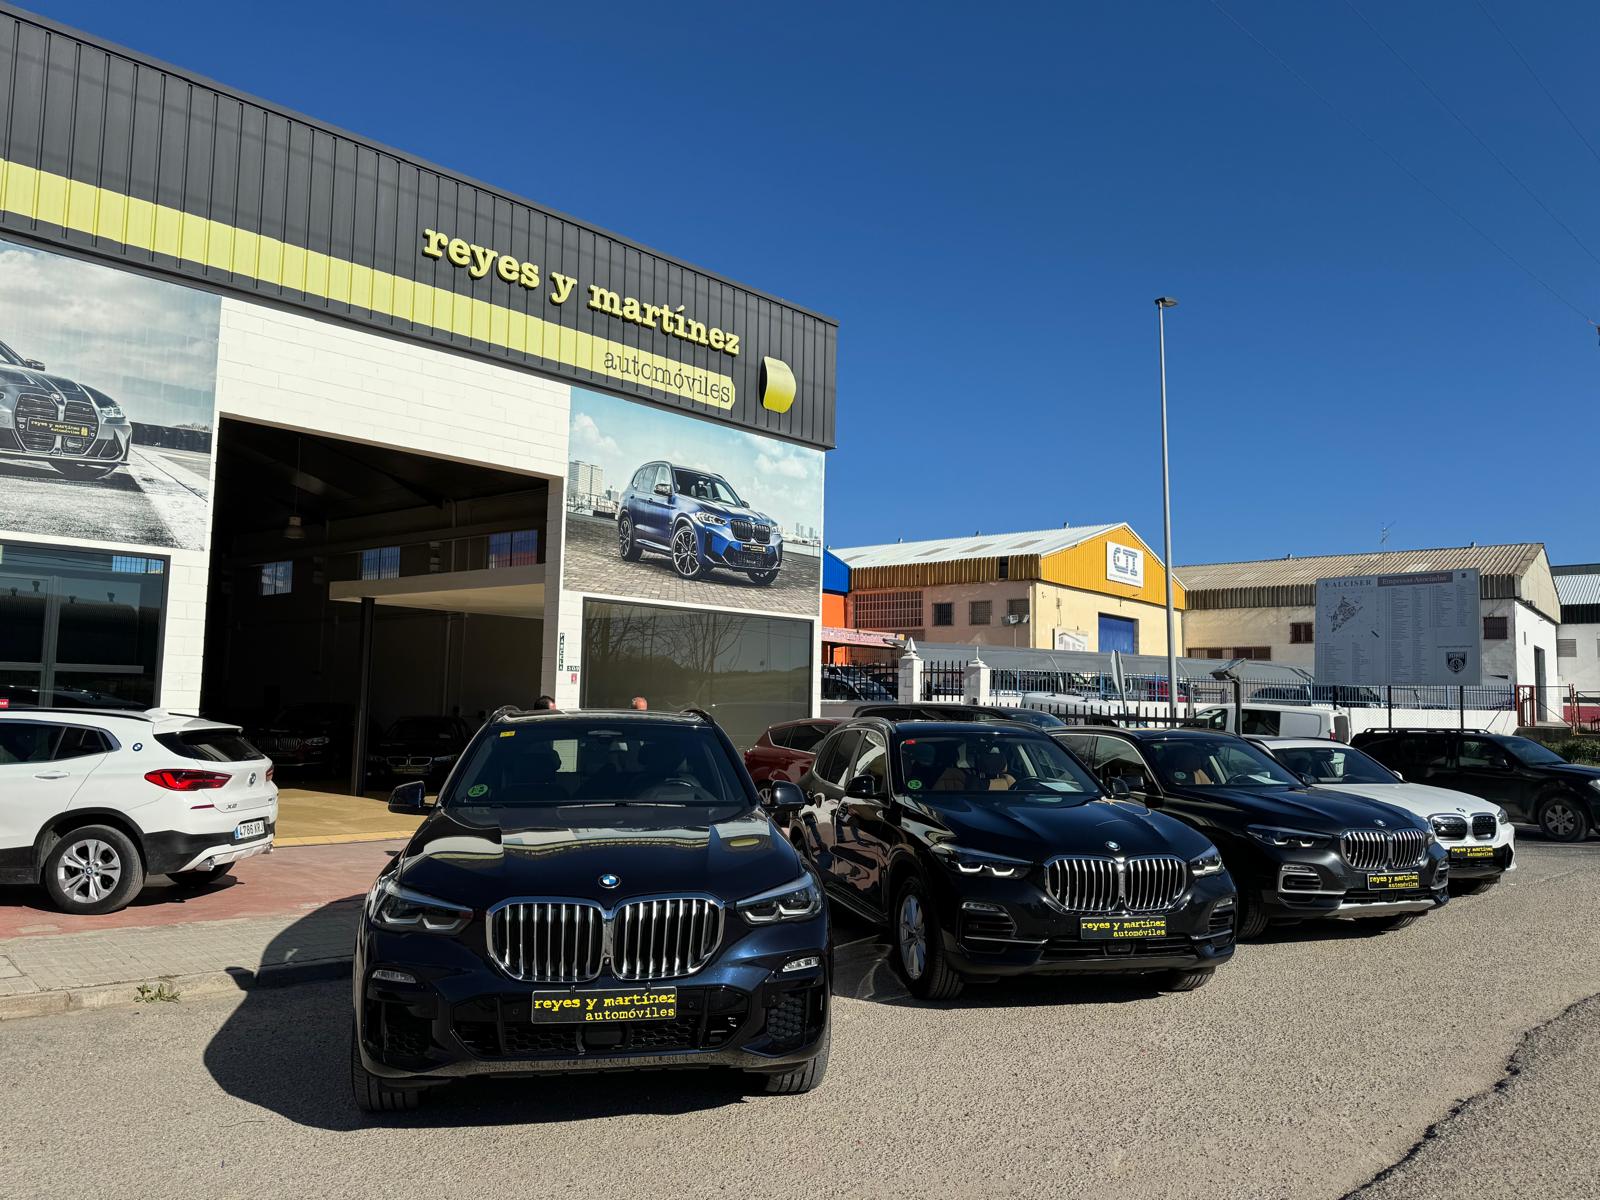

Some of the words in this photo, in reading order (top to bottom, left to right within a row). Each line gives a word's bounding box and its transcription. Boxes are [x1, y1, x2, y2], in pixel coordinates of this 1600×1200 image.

[423, 228, 540, 289] reyes
[550, 272, 577, 304] y
[588, 284, 740, 356] martínez
[604, 352, 730, 403] automóviles
[1082, 922, 1110, 931] reyes
[1113, 922, 1120, 930] y
[1123, 919, 1166, 929] martínez
[1113, 929, 1166, 937] automóviles
[534, 998, 581, 1011] reyes
[585, 998, 597, 1010] y
[603, 992, 676, 1007] martínez
[585, 1007, 675, 1021] automóviles
